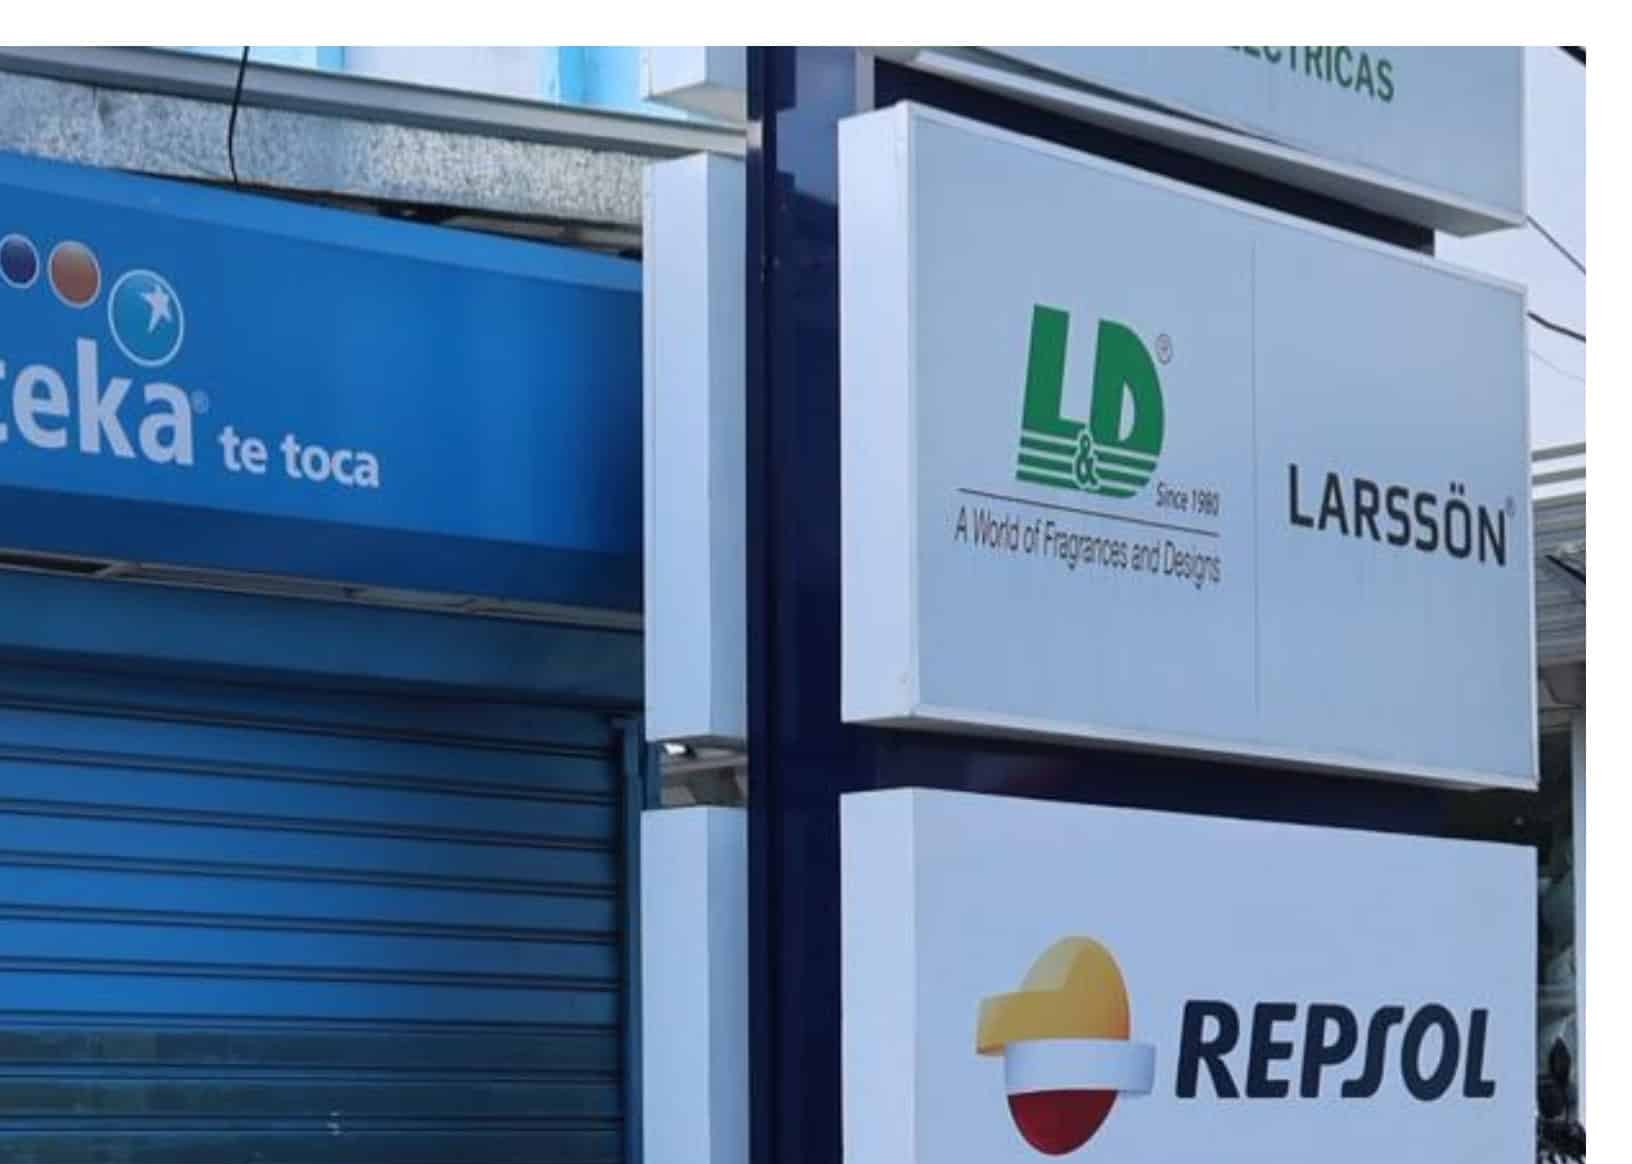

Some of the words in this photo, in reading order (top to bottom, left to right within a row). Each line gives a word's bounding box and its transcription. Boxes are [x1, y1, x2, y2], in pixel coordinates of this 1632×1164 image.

[1017, 304, 1166, 499] L&D
[219, 426, 268, 474] te
[280, 433, 379, 488] toca
[1156, 481, 1188, 512] Since
[1191, 489, 1221, 516] 1980
[954, 505, 968, 543] A
[973, 507, 1018, 551] World
[1024, 519, 1043, 554] of
[1044, 520, 1128, 571] Fragrances
[1131, 539, 1161, 574] and
[1163, 540, 1221, 590] Designs
[1289, 463, 1507, 567] LARSSÖN
[1176, 1000, 1496, 1101] REPSOL
